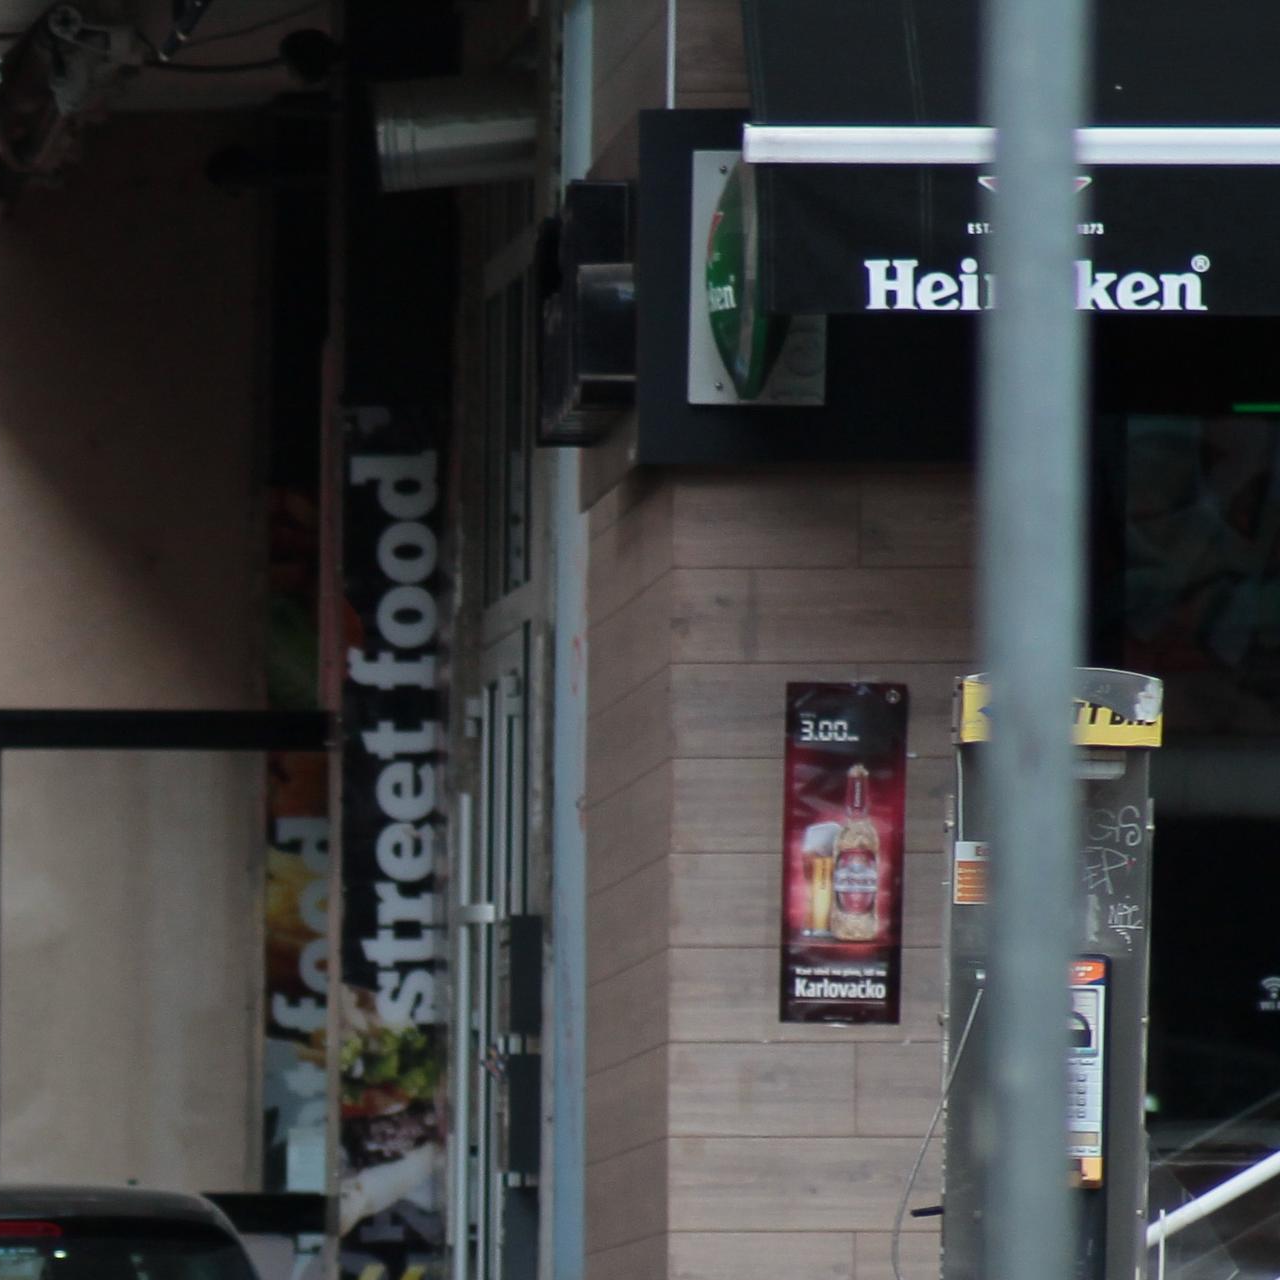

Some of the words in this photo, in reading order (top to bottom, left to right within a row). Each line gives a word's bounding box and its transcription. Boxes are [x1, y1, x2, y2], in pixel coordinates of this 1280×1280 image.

[864, 257, 1208, 311] Heiken
[347, 452, 438, 690] food
[360, 719, 438, 1030] street
[795, 978, 886, 999] Karlovačko
